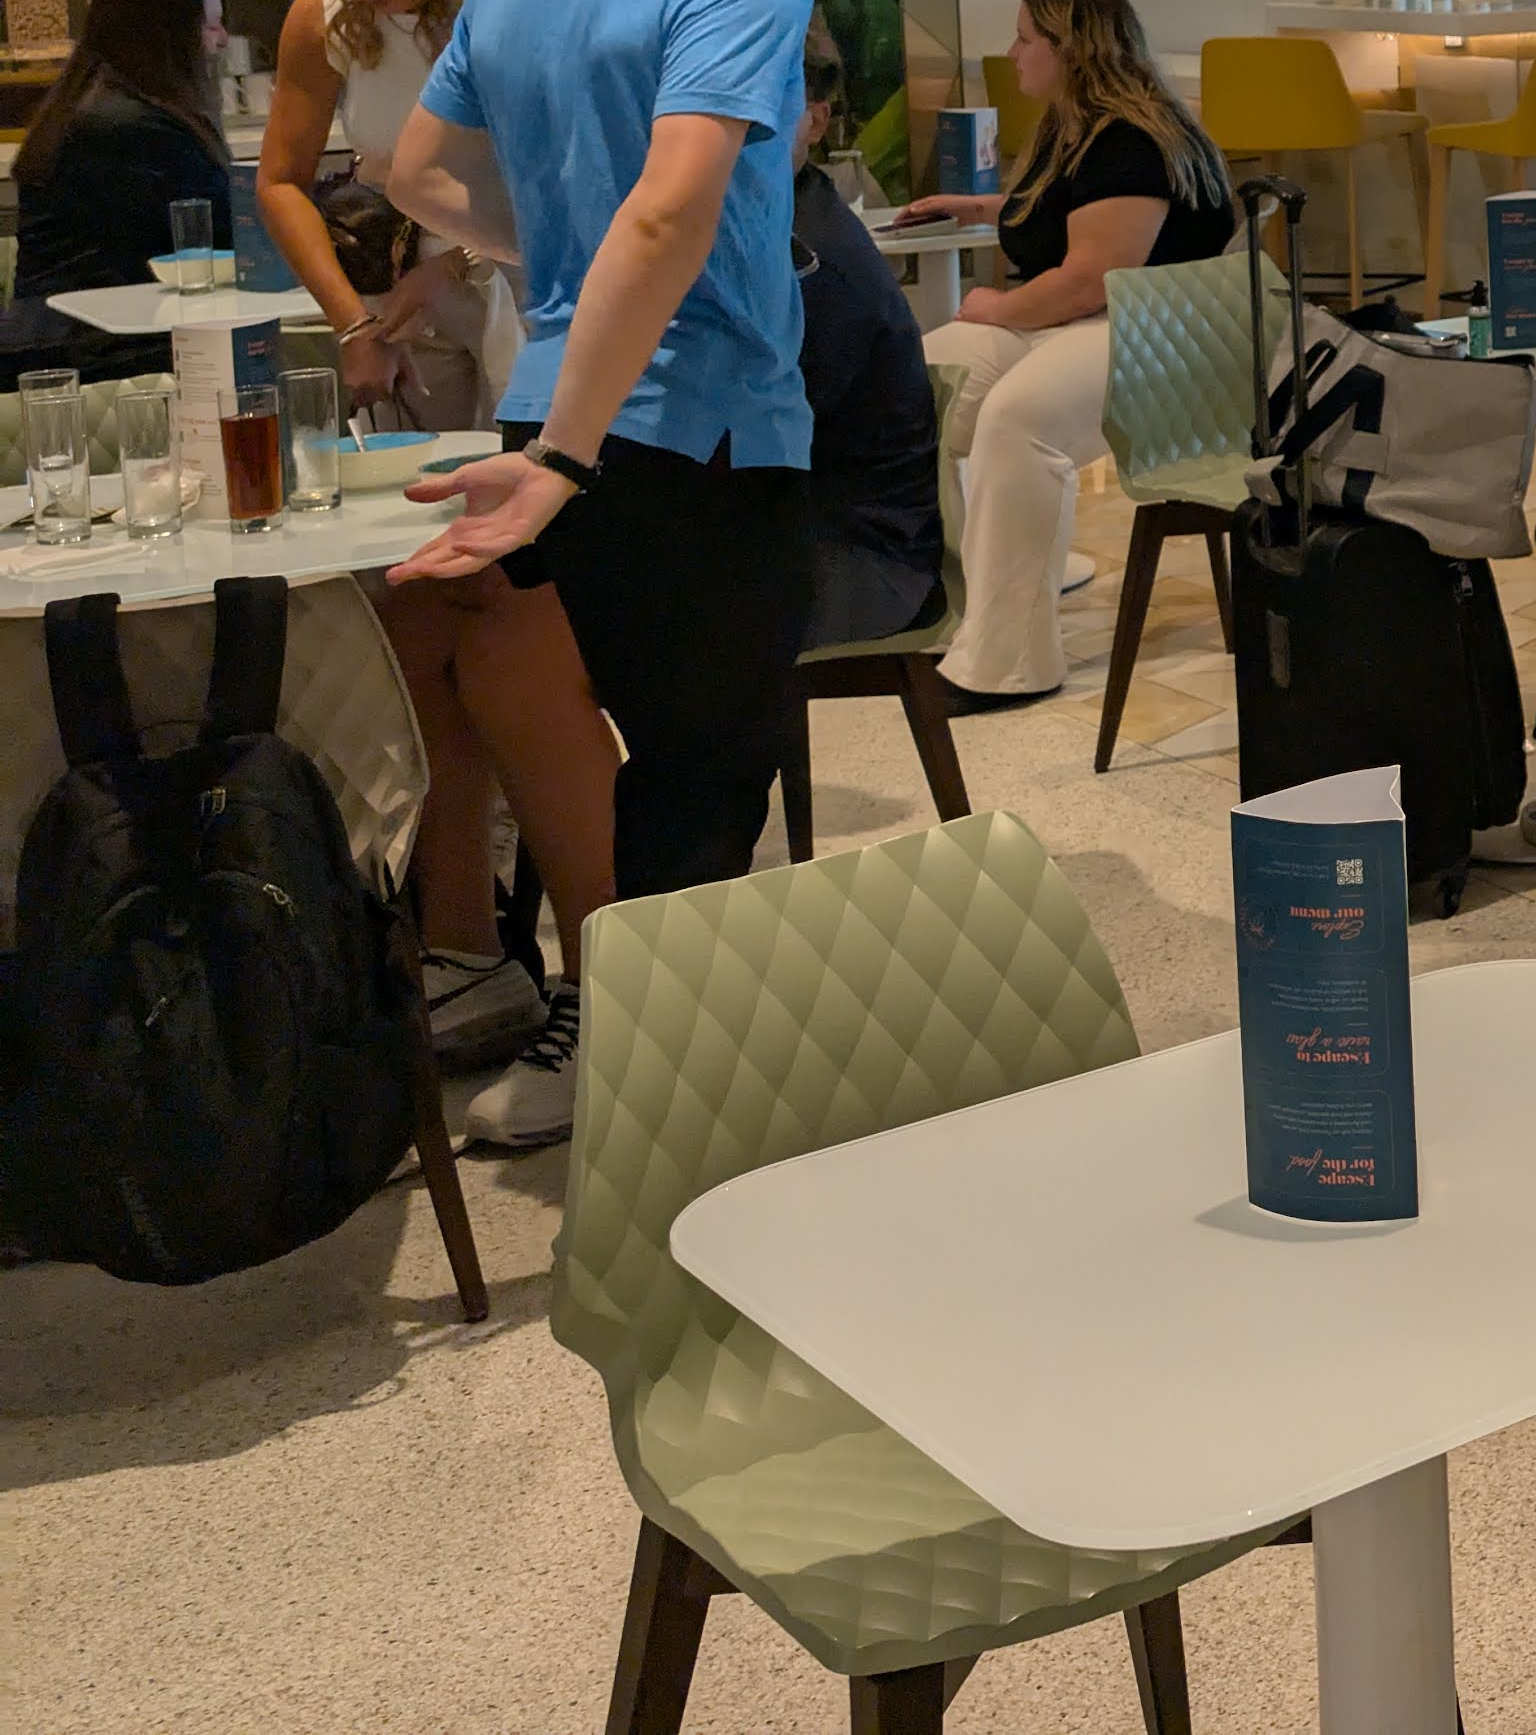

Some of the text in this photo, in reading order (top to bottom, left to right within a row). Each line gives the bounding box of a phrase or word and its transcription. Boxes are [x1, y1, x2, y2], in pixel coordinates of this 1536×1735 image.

[1290, 906, 1365, 919] our menu
[1296, 1050, 1371, 1064] Escape to
[1322, 1158, 1347, 1172] the
[1349, 1158, 1375, 1171] for
[1318, 1172, 1375, 1186] Escape
